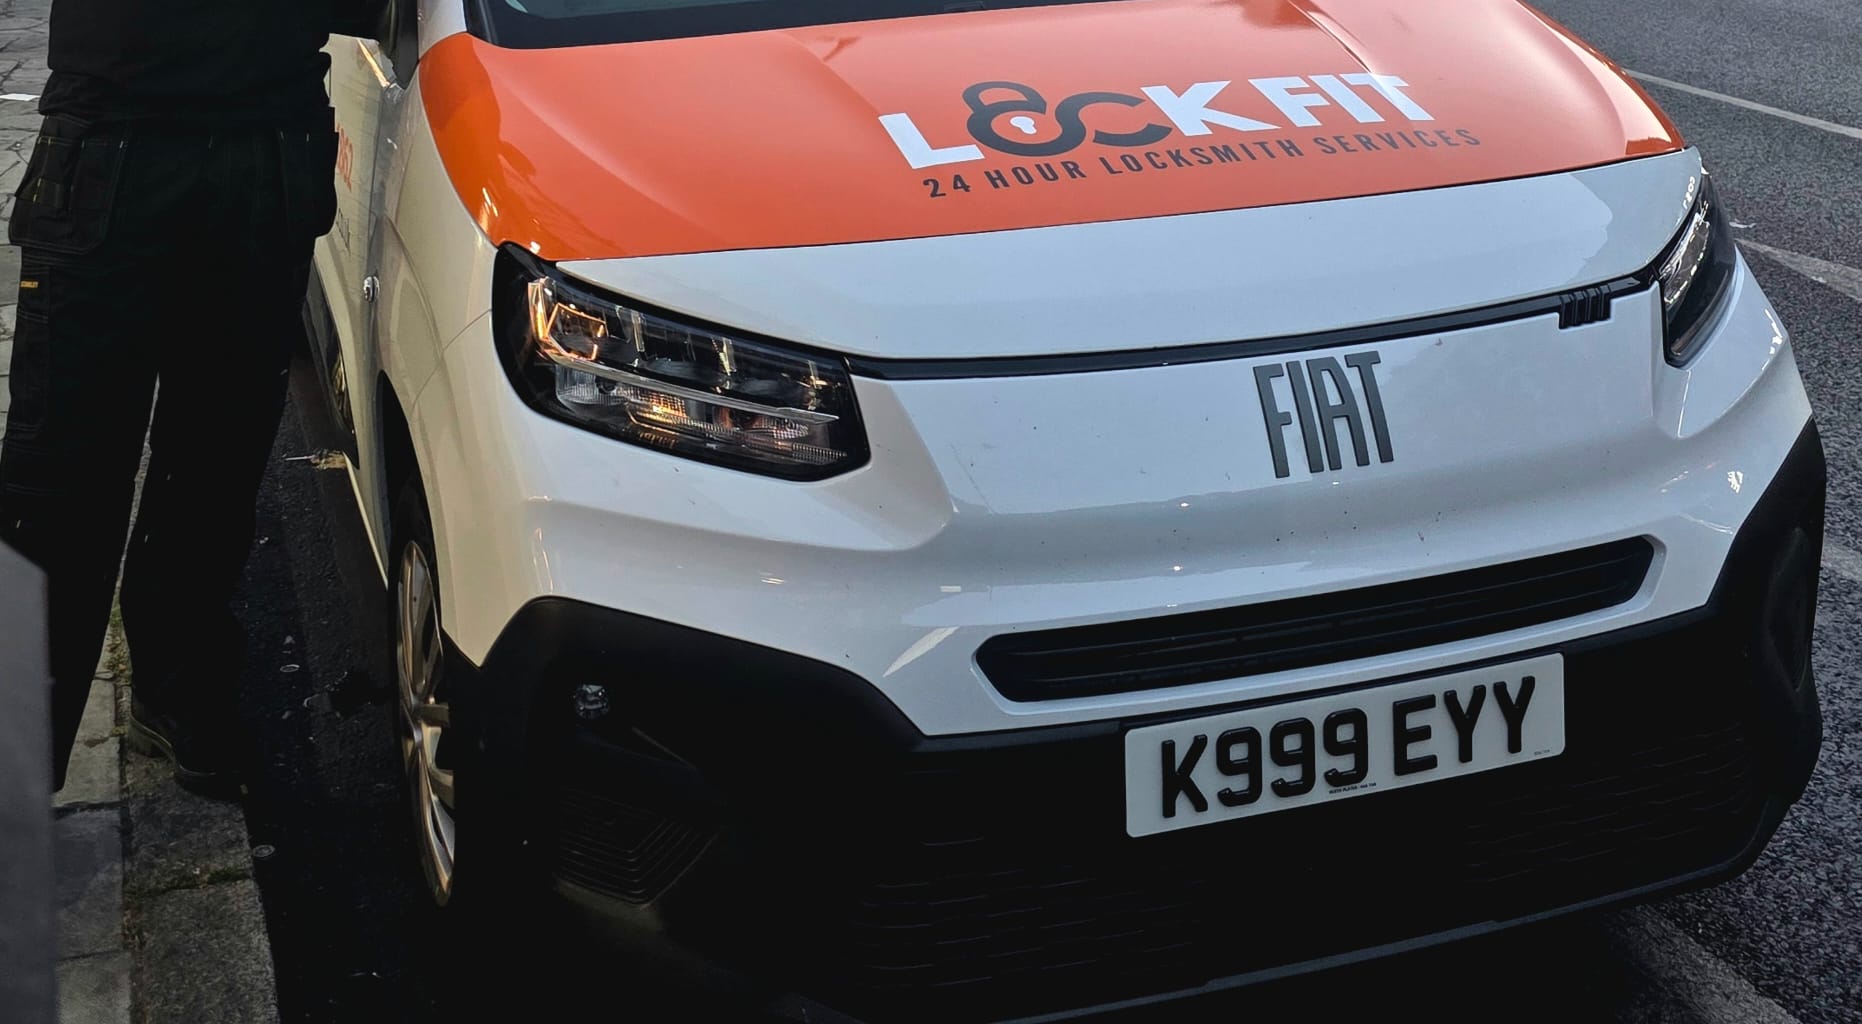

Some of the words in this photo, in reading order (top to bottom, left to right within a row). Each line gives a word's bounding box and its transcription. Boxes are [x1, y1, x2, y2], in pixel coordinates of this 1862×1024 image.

[922, 177, 972, 199] 24
[985, 160, 1087, 189] HOUR
[1100, 139, 1304, 176] LOCKSMITH
[1319, 128, 1481, 156] SERVICES
[1253, 351, 1394, 478] FIAT
[1162, 707, 1368, 818] K999
[1393, 676, 1535, 776] EYY
